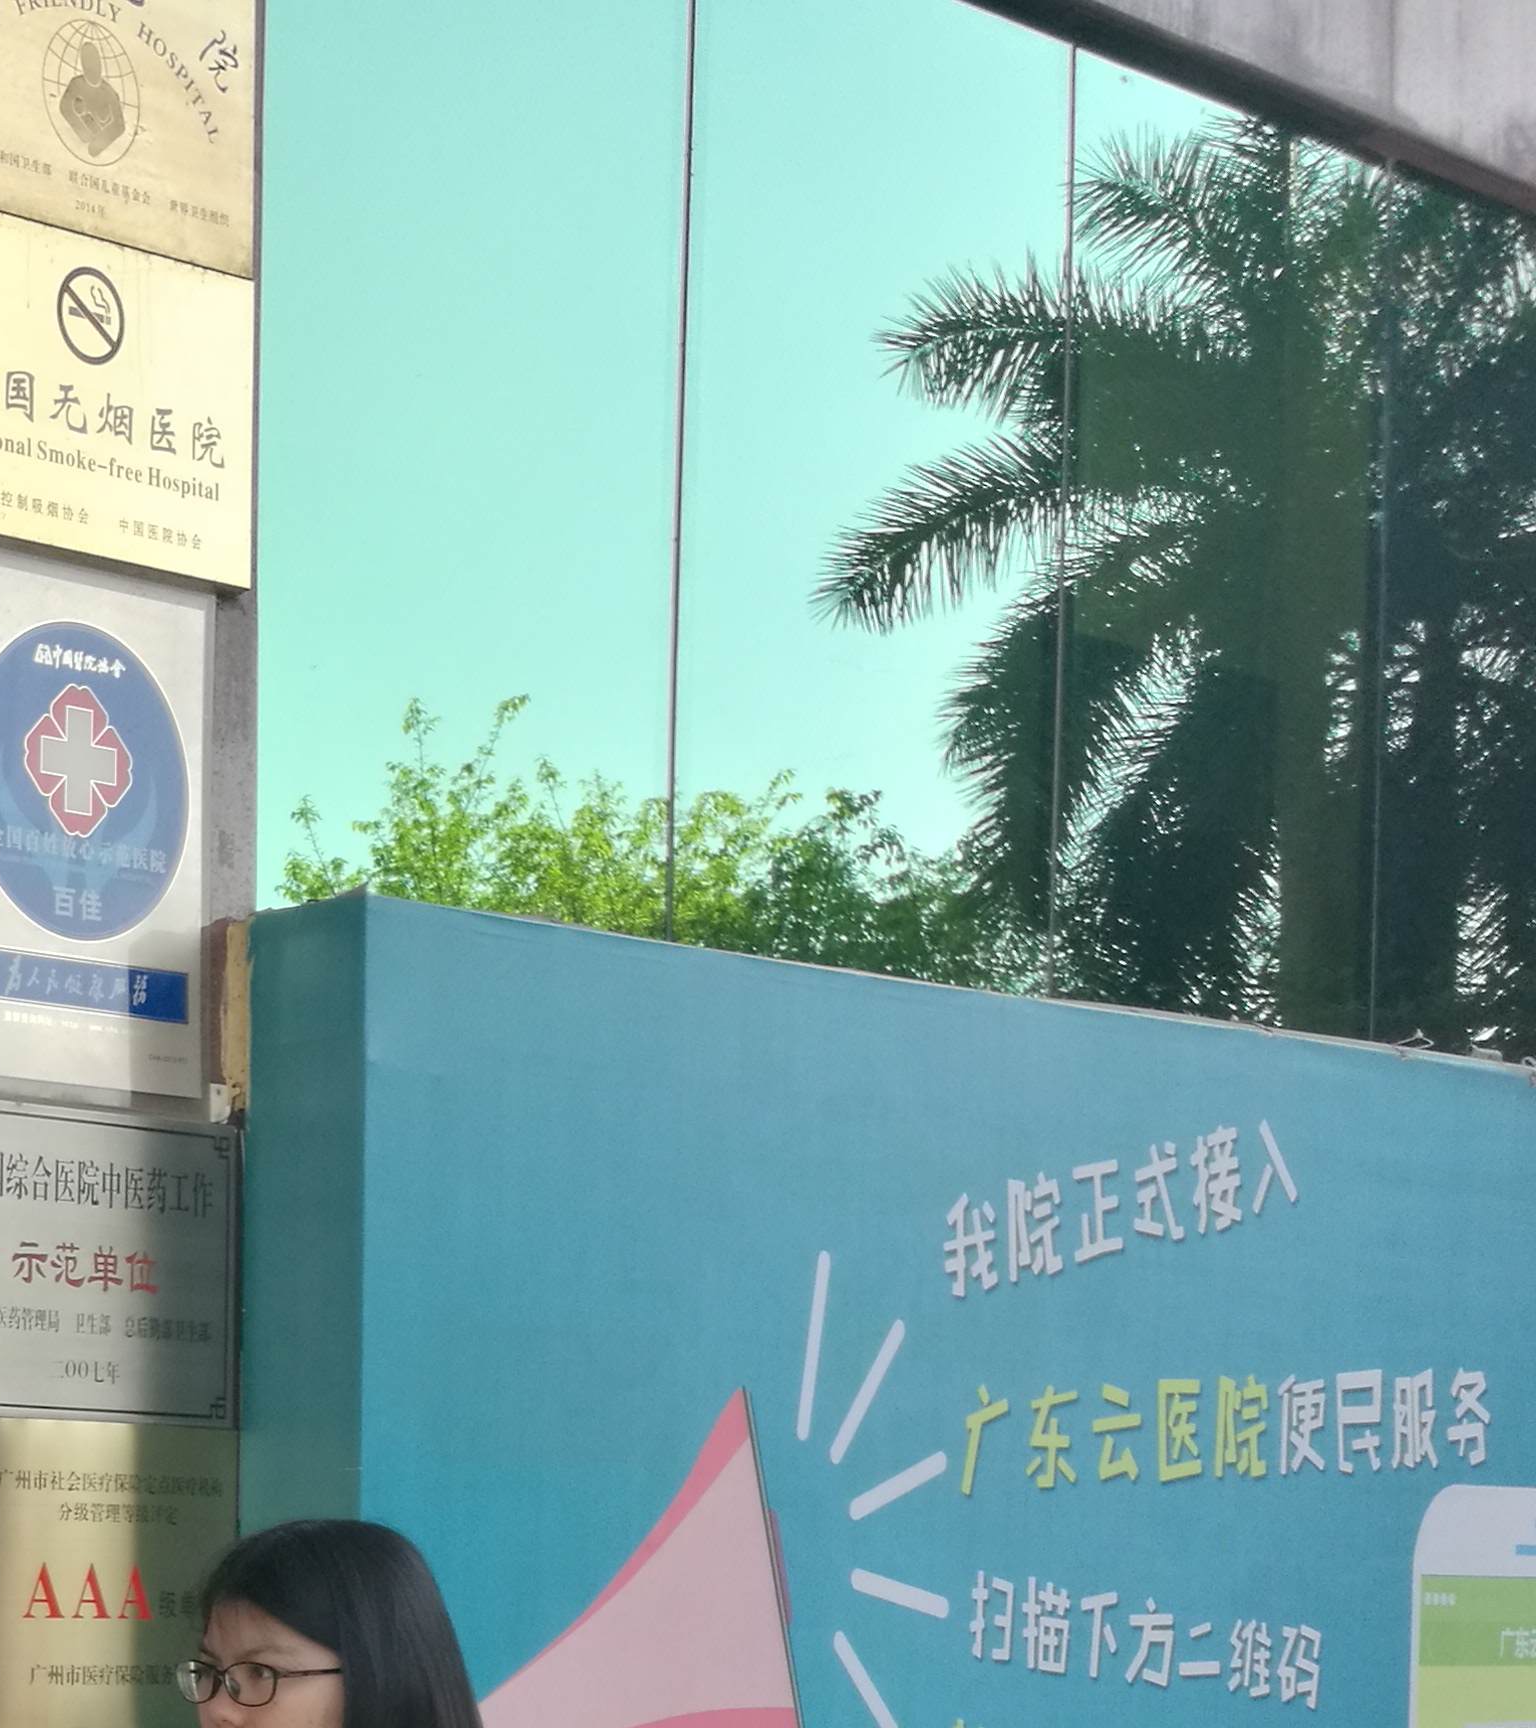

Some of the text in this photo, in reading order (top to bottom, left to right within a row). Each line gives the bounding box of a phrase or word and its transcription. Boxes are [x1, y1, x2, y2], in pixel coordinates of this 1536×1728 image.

[136, 22, 222, 145] HOSPITAL
[147, 466, 221, 502] Hospital
[118, 518, 203, 551] 中国医院协会
[52, 886, 104, 922] 百佳
[943, 1118, 1299, 1299] 我院正式接入
[11, 1241, 160, 1295] 示范单位
[74, 1313, 113, 1338] 卫生部
[959, 1366, 1491, 1496] 广东云医院便民服务
[22, 1561, 154, 1620] AAA
[968, 1570, 1323, 1710] 扫描下方二维码
